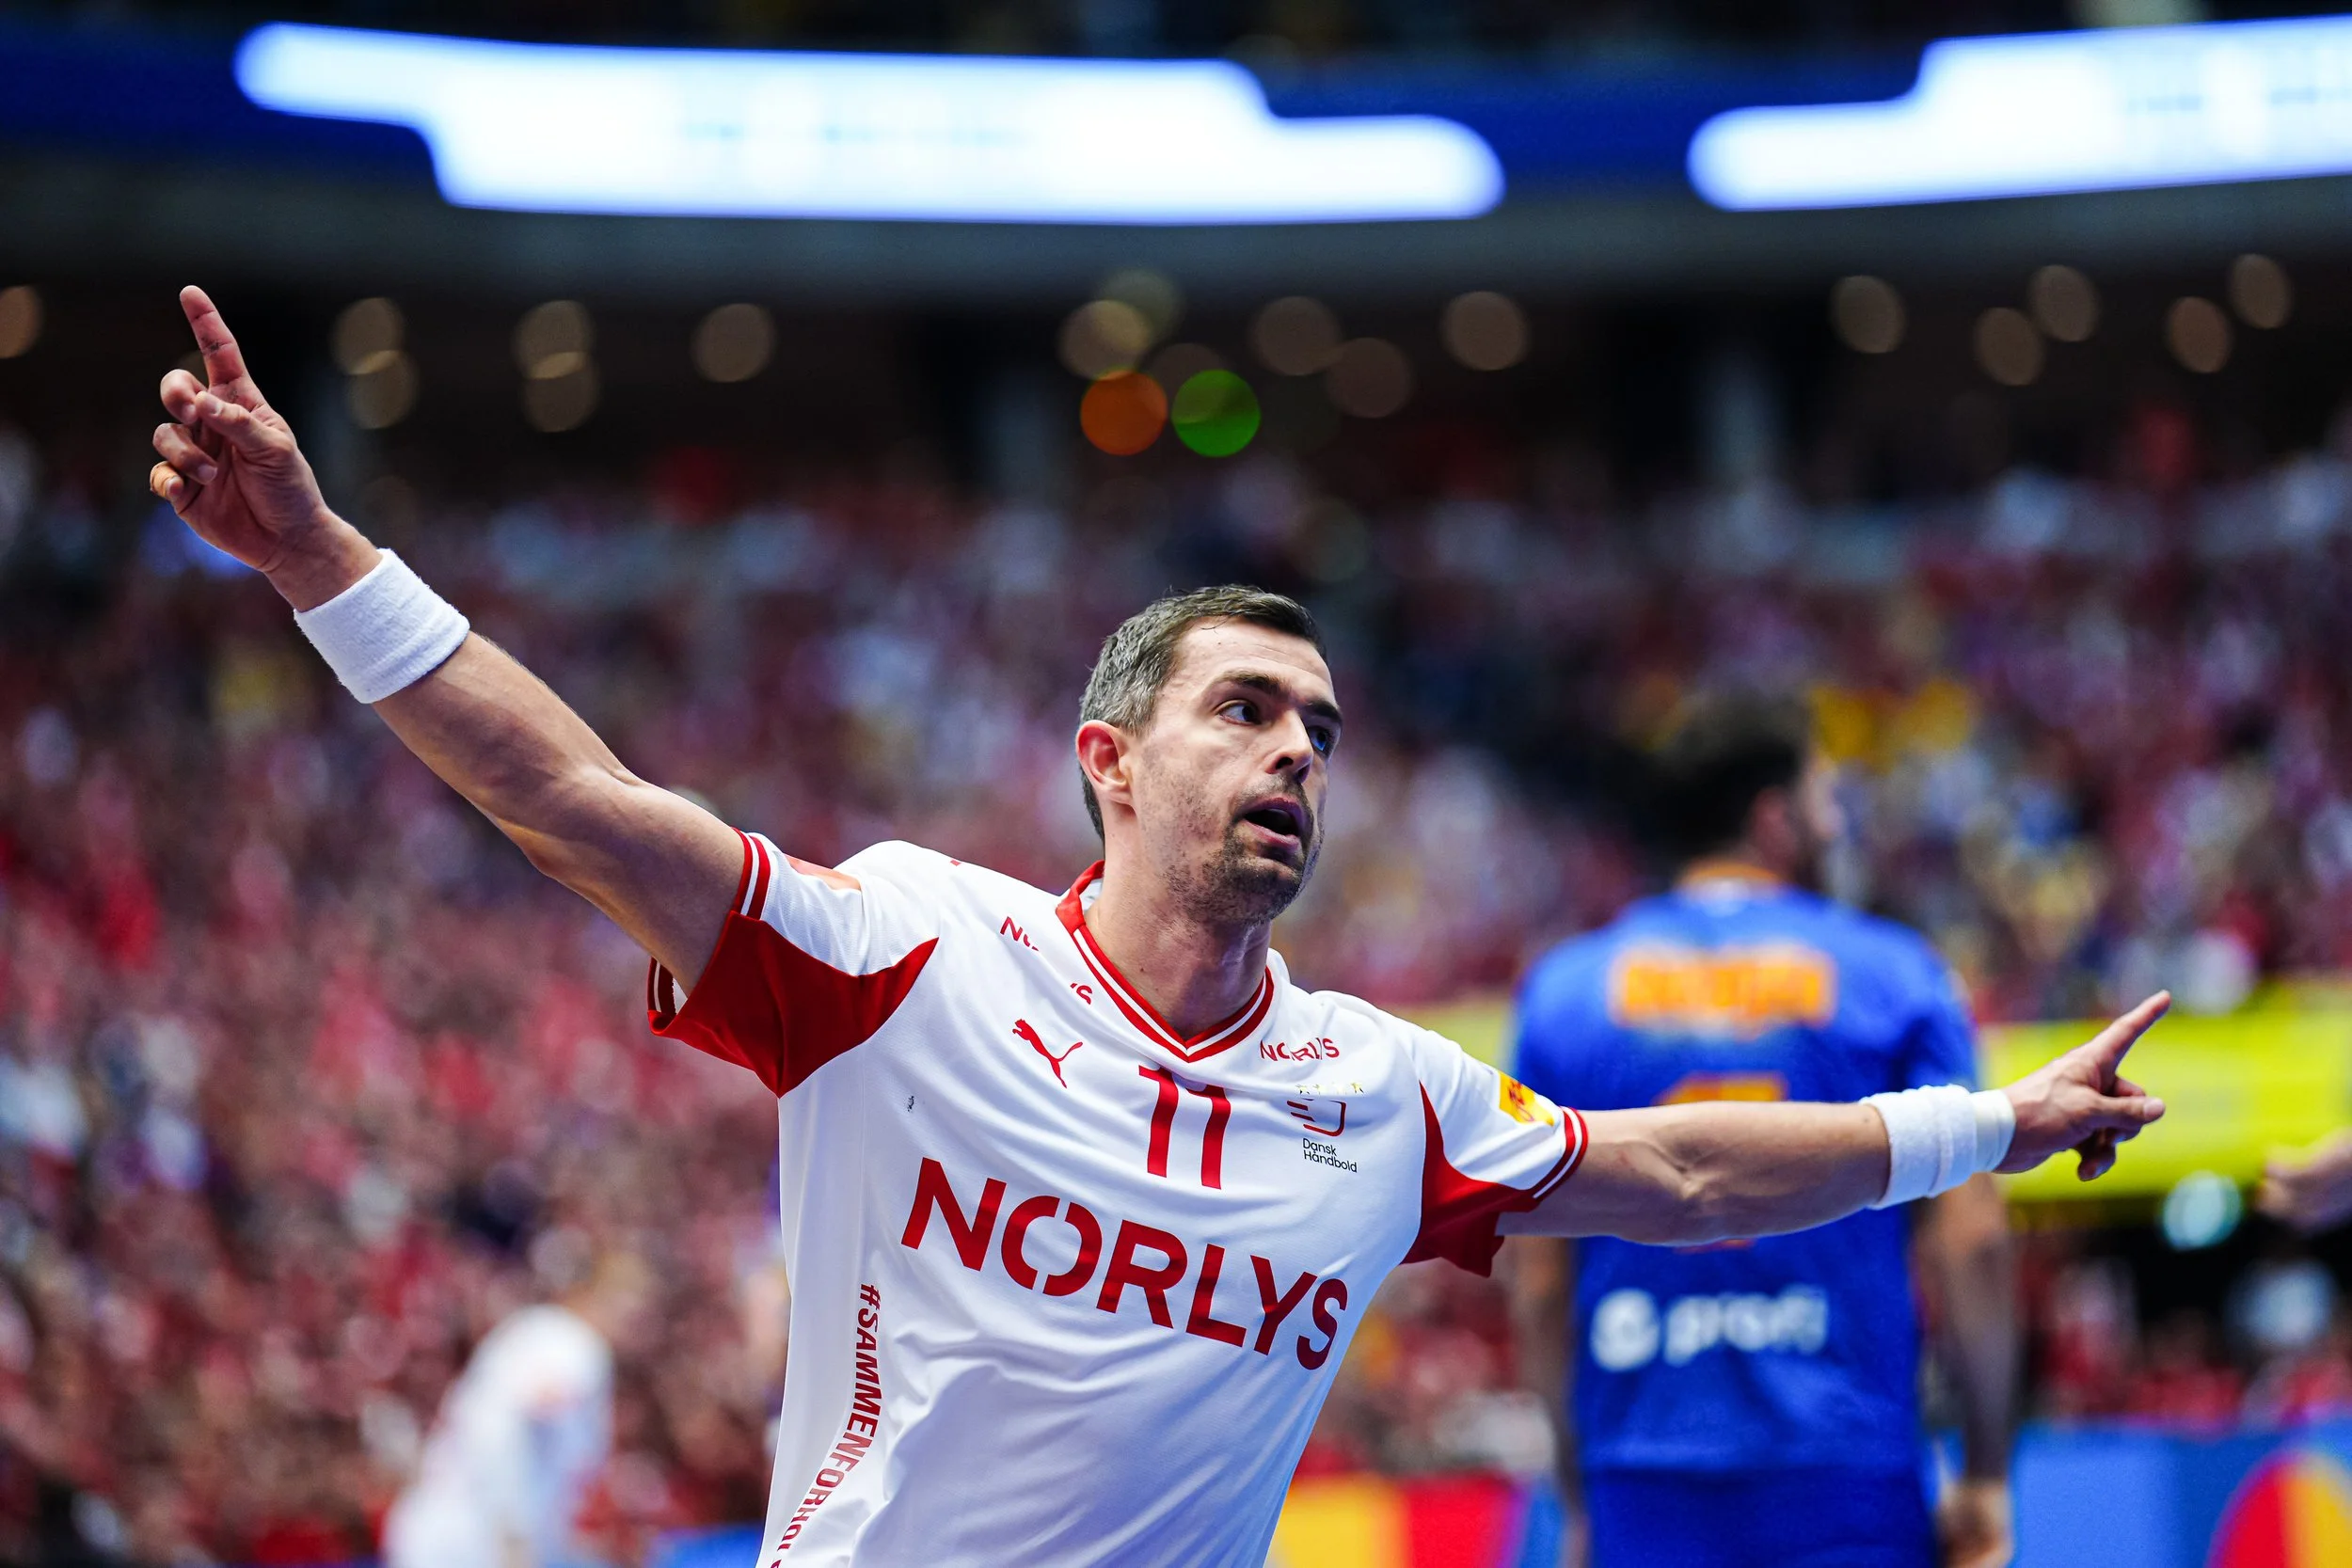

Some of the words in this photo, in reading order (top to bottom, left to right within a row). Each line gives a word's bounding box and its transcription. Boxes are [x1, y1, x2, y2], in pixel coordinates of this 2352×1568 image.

[1138, 1065, 1232, 1190] 11
[1302, 1137, 1338, 1157] Dansk
[1303, 1149, 1359, 1173] Håndbold
[900, 1157, 1349, 1370] NORLYS
